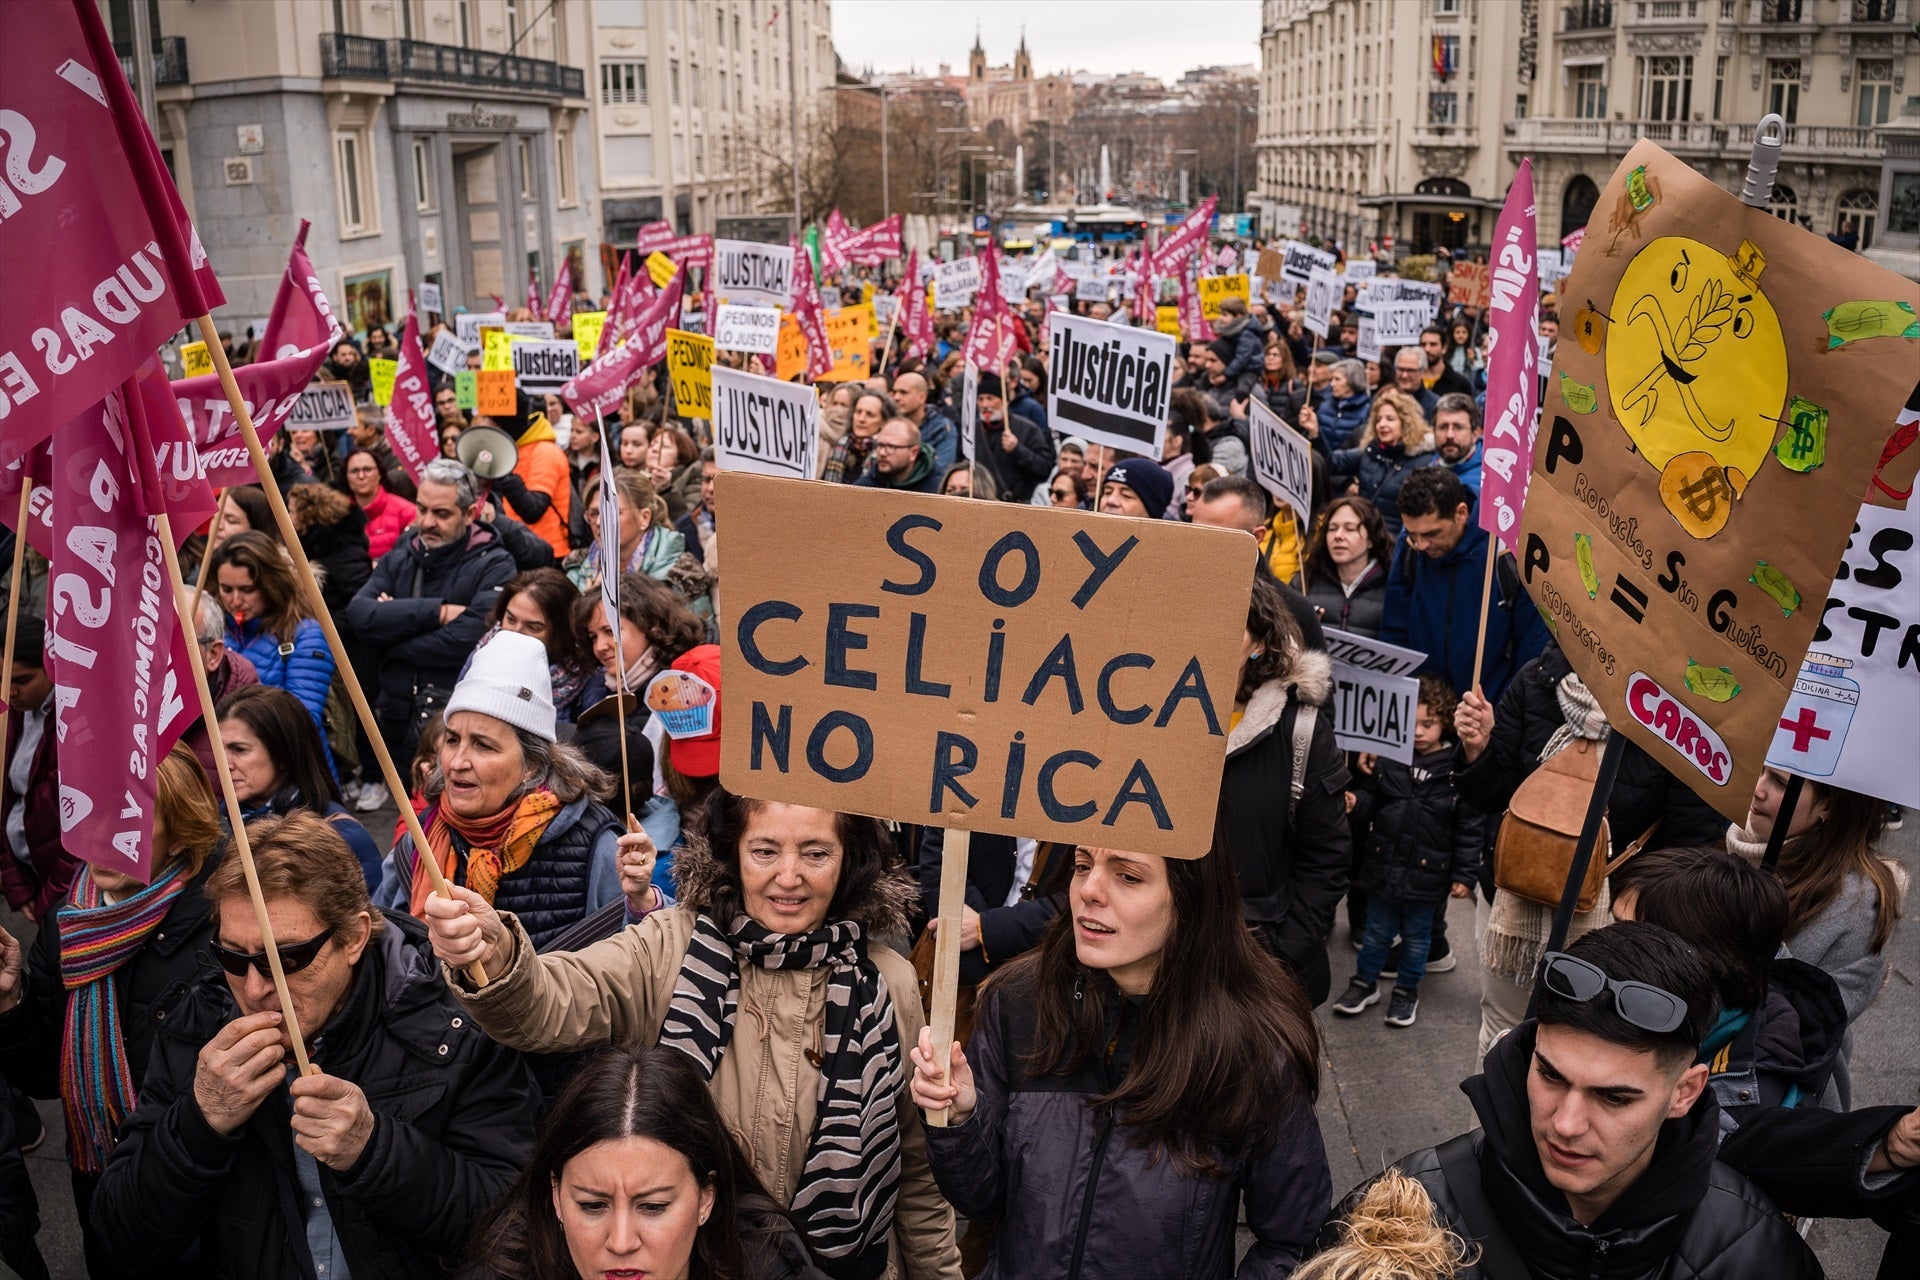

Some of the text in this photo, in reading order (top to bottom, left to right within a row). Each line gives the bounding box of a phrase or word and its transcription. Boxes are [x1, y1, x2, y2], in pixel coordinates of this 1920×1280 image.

[718, 250, 790, 293] ¡JUSTICIA!
[513, 347, 578, 377] ¡Justicia!
[674, 379, 692, 407] LO
[1050, 327, 1171, 421] ¡Justicia!
[879, 513, 1140, 610] SOY
[1333, 681, 1410, 744] TICIA!
[1795, 680, 1831, 697] EDICINA
[750, 700, 875, 784] NO
[1629, 678, 1729, 782] CAROS
